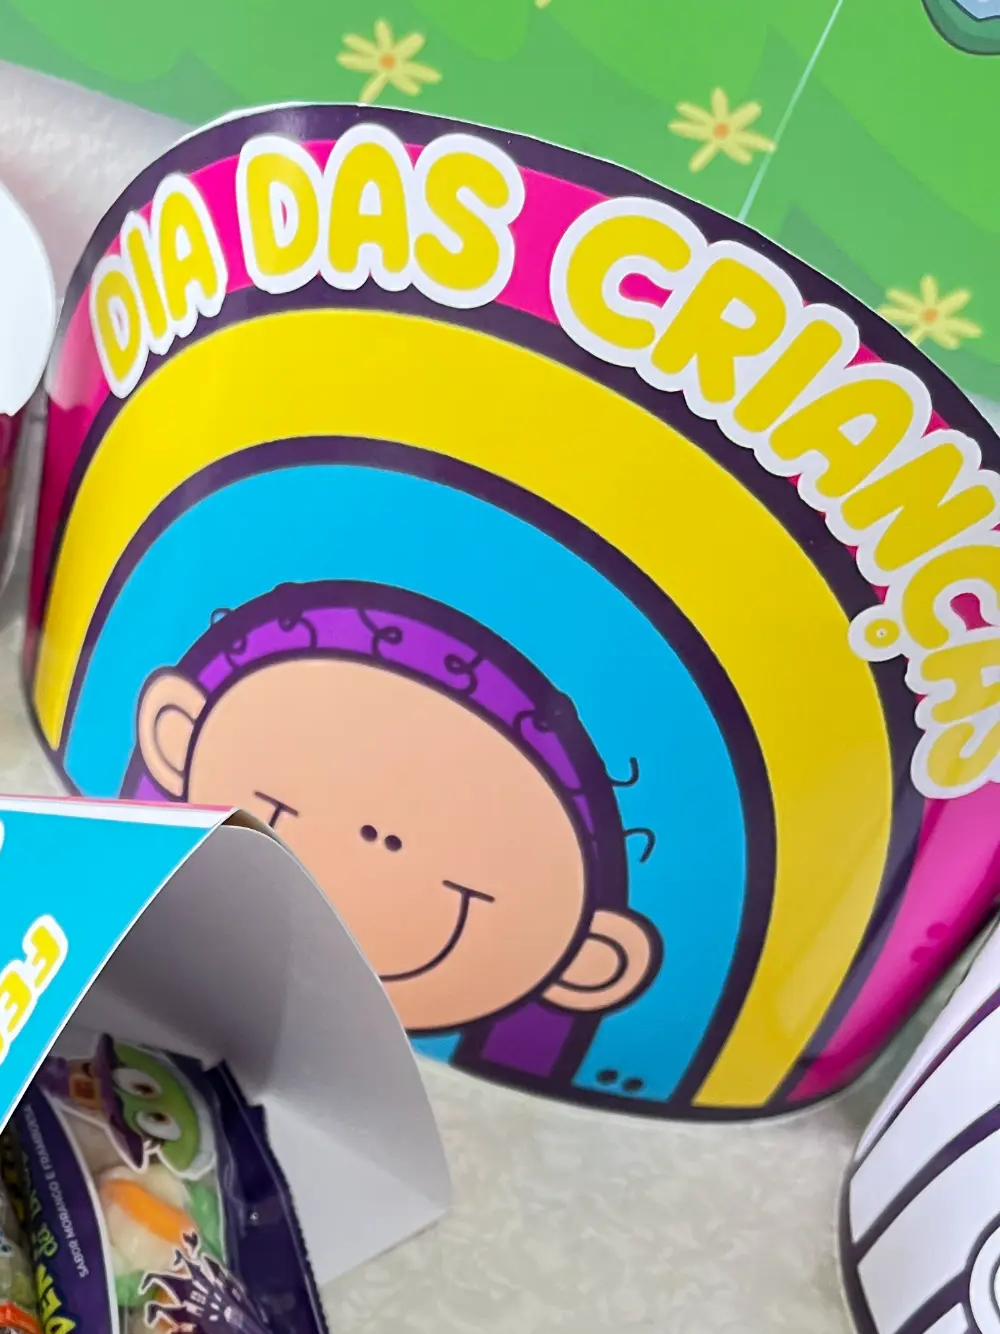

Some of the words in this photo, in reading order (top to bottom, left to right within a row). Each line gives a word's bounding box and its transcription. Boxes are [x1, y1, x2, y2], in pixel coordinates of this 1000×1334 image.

[90, 173, 228, 397] DIA
[237, 125, 525, 309] DAS
[551, 195, 1000, 799] CRIANÇAS
[49, 1179, 74, 1239] MORANGO
[68, 1239, 89, 1278] SABOR
